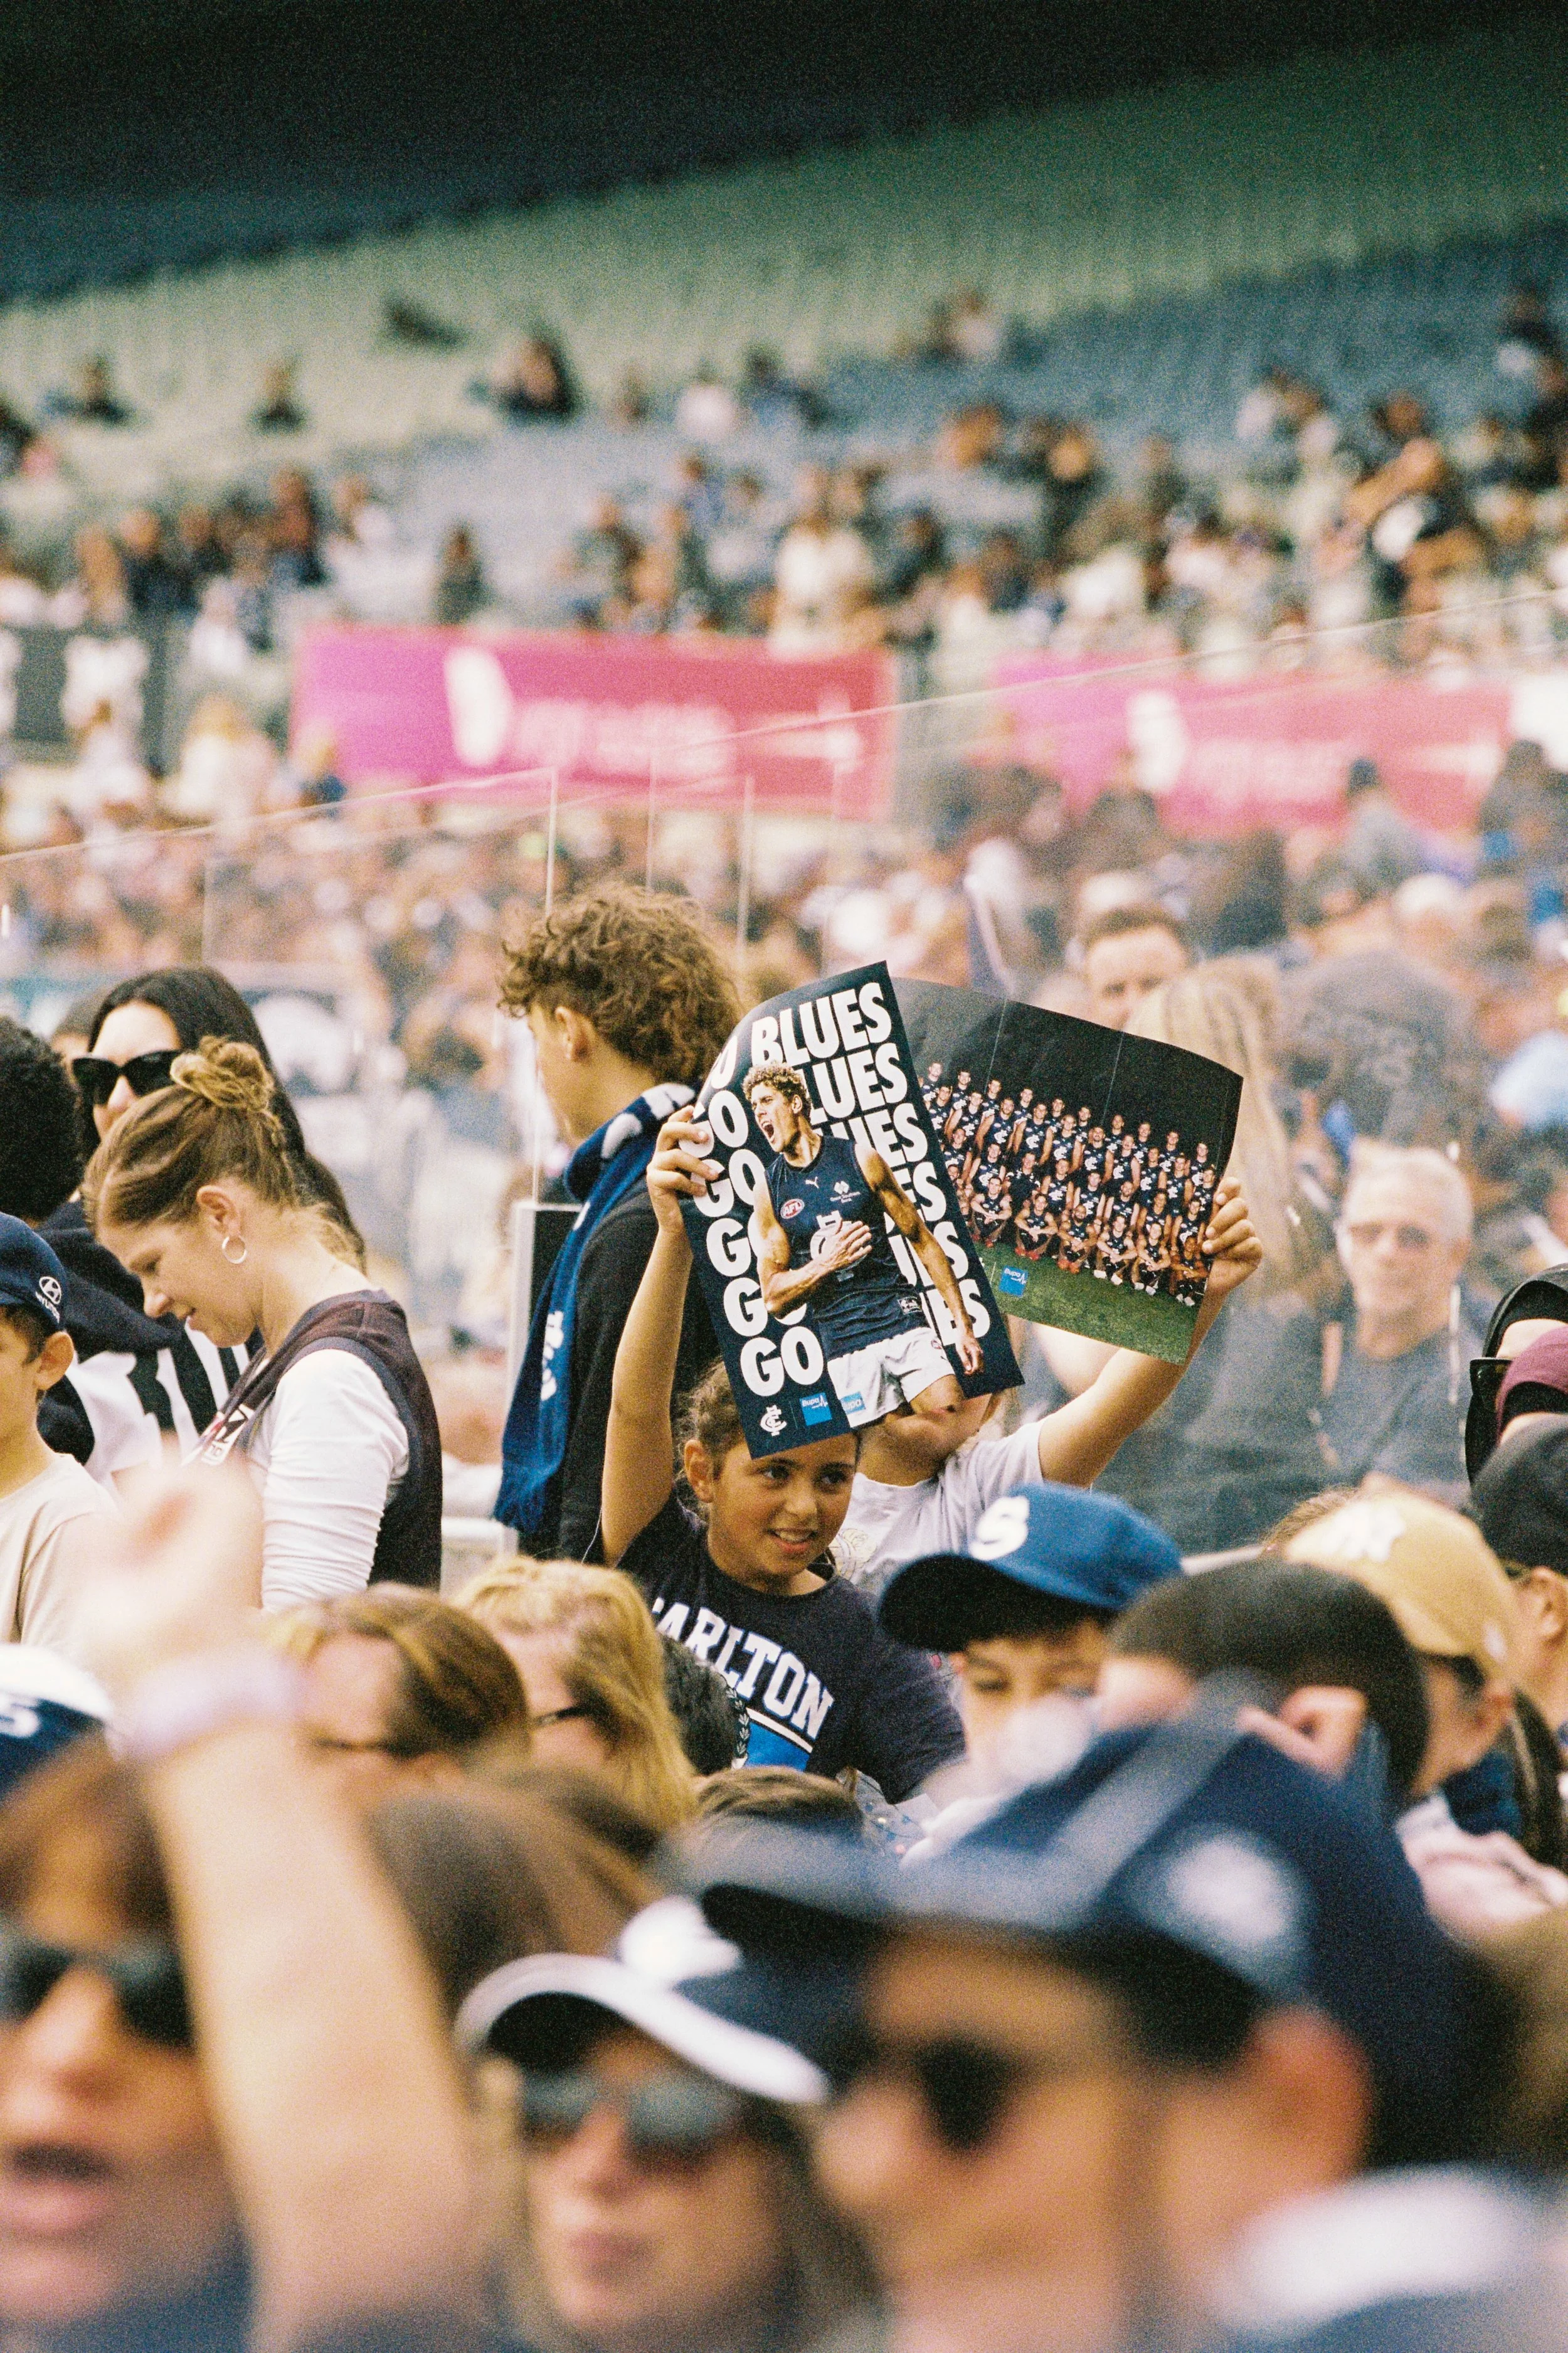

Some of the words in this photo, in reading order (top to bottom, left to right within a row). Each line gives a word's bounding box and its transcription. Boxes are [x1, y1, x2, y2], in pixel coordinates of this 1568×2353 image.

[751, 982, 892, 1068] BLUES
[793, 1042, 908, 1125] LUES
[690, 1149, 766, 1218] GO
[706, 1212, 758, 1277] G
[723, 1277, 807, 1337] G
[740, 1325, 824, 1397] GO
[652, 1596, 835, 1741] ARLTON
